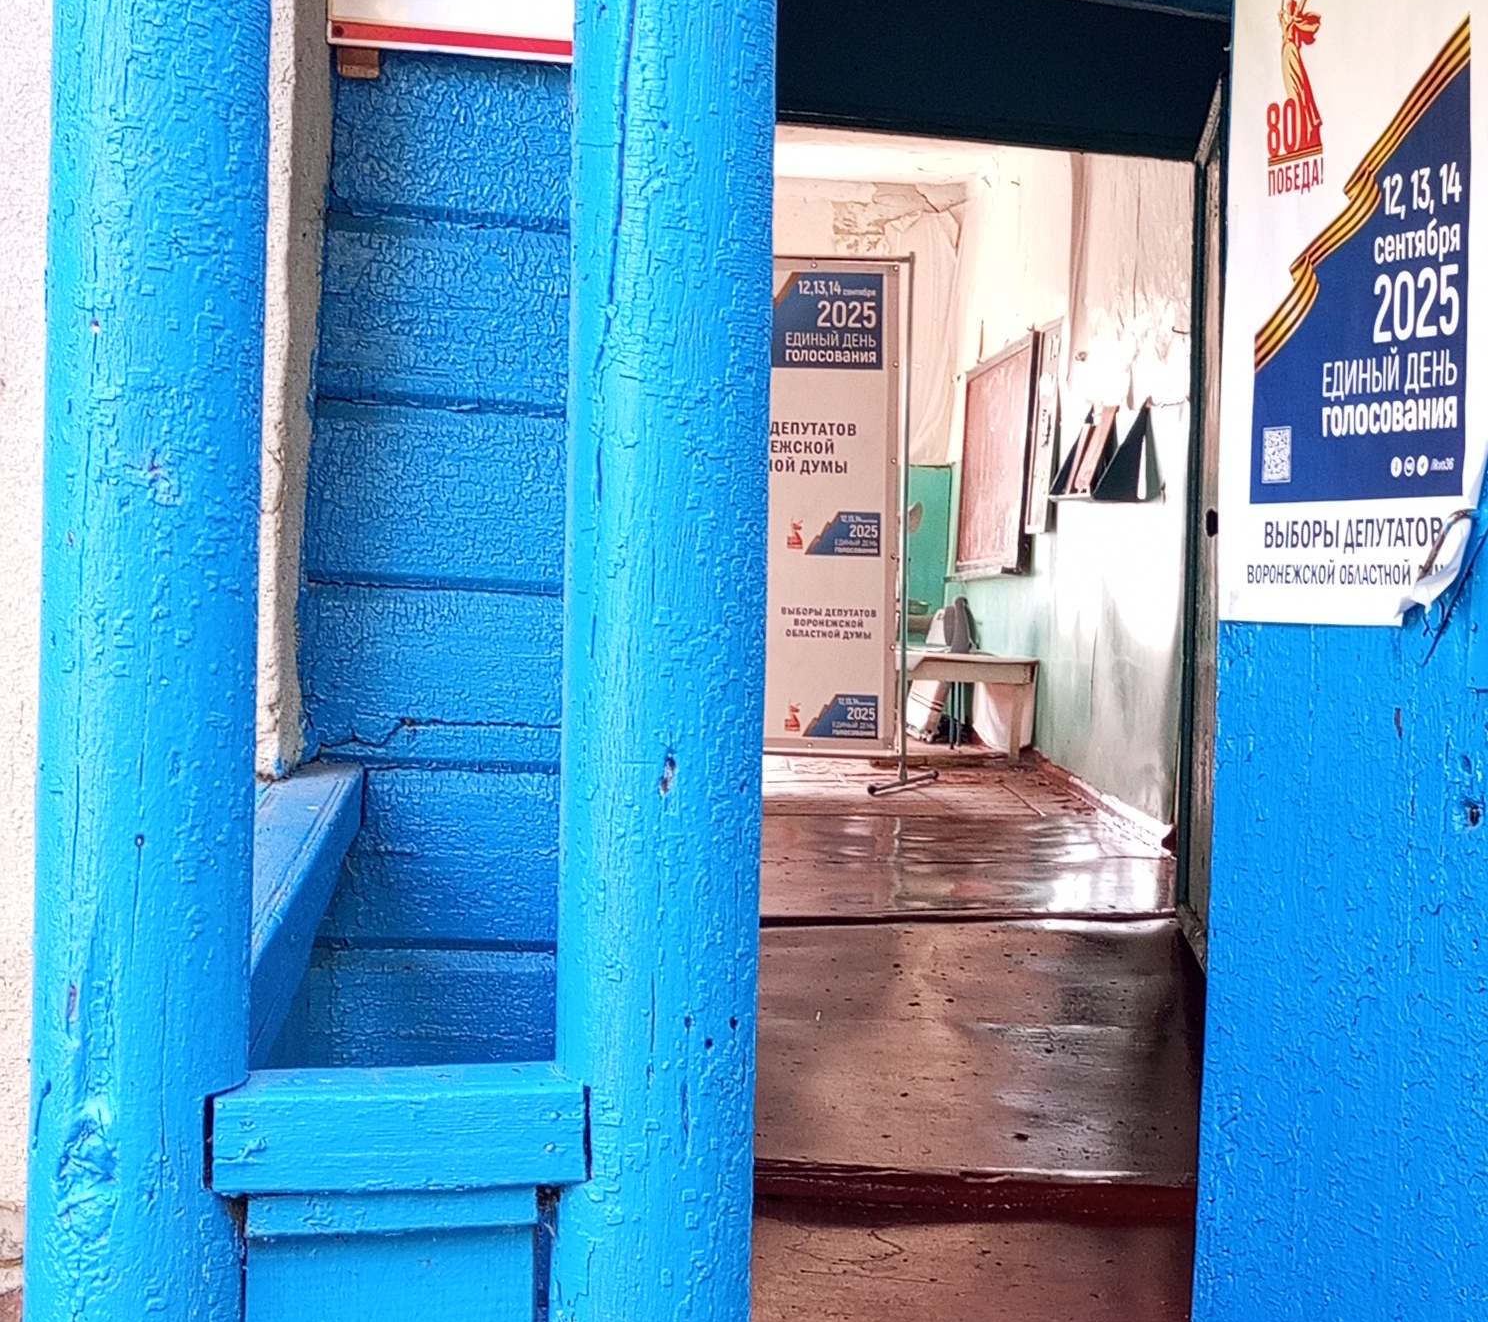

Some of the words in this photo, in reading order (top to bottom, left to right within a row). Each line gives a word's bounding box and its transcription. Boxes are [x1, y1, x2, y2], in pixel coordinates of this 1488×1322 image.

[1268, 157, 1324, 197] ПОБЕДА!
[1383, 173, 1405, 219] 12,
[1411, 167, 1434, 214] 13,
[1439, 162, 1462, 204] 14
[1374, 218, 1460, 264] сентября
[1373, 264, 1459, 344] 2025
[817, 300, 877, 328] 2025
[785, 330, 839, 347] ЕДИНЫЙ
[842, 333, 876, 348] ДЕНЬ
[785, 349, 876, 363] голосования
[1322, 346, 1399, 402] ЕДИНЫЙ
[1404, 349, 1457, 394] ДЕНЬ
[1322, 396, 1457, 437] голосования
[769, 421, 857, 436] ДЕПУТАТОВ
[770, 439, 834, 454] ЕЖСКОЙ
[800, 460, 848, 475] ДУМЫ
[849, 524, 878, 538] 2025
[1264, 519, 1340, 548] ВЫБОРЫ
[1343, 517, 1443, 554] ДЕПУТАТОВ
[1247, 559, 1335, 585] ВОРОНЕЖСКОЙ
[1339, 559, 1411, 585] ОБЛАСТНОЙ
[781, 606, 822, 616] ВЫБОРЫ
[824, 608, 877, 618] ДЕПУТАТОВ
[794, 618, 863, 628] ВОРОНЕЖСКОЙ
[785, 628, 840, 639] ОБЛАСТНОЙ
[842, 630, 872, 640] ДУМЫ
[846, 707, 876, 720] 2025
